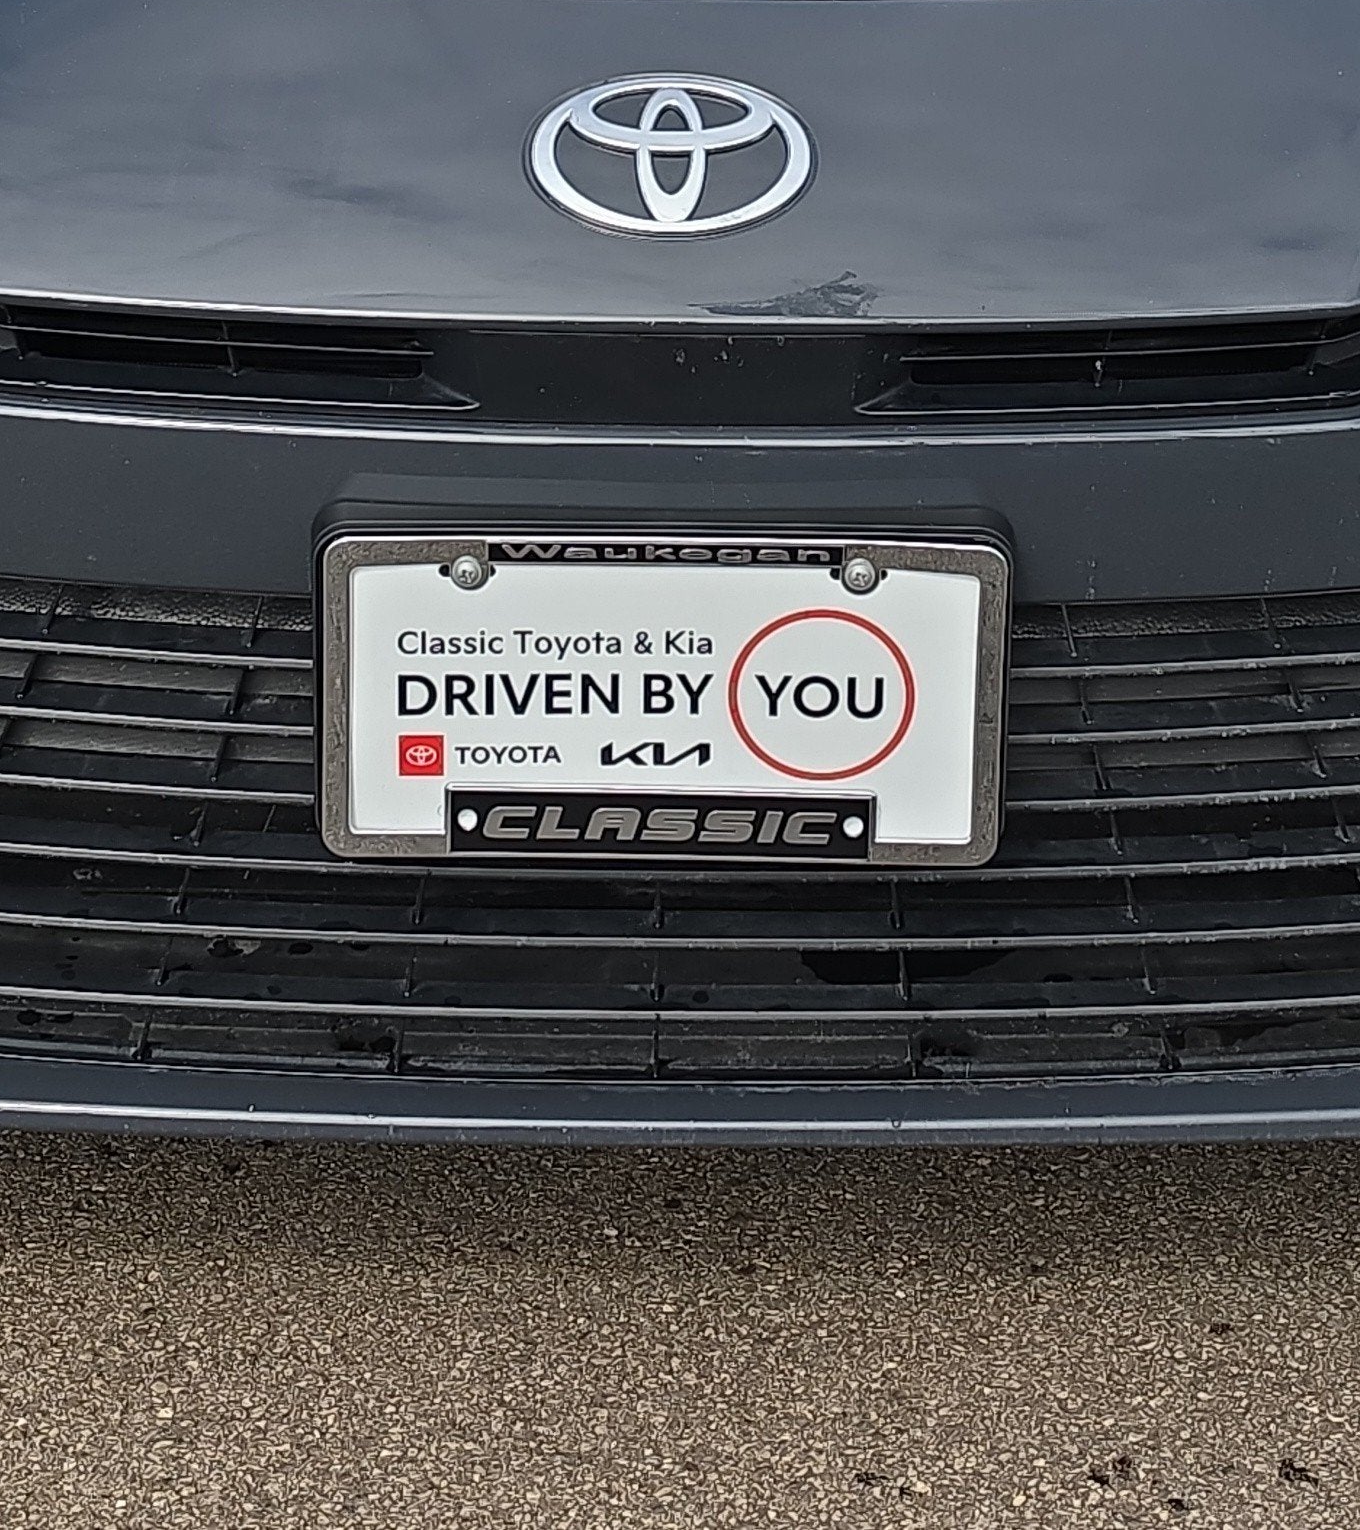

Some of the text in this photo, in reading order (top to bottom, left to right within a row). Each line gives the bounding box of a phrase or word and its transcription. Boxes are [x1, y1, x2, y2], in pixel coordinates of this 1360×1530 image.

[397, 630, 713, 660] Classic Toyota & Kia
[397, 673, 884, 719] DRIVEN BY YOU
[454, 745, 562, 765] TOYOTA
[481, 805, 838, 845] CLASSIC
